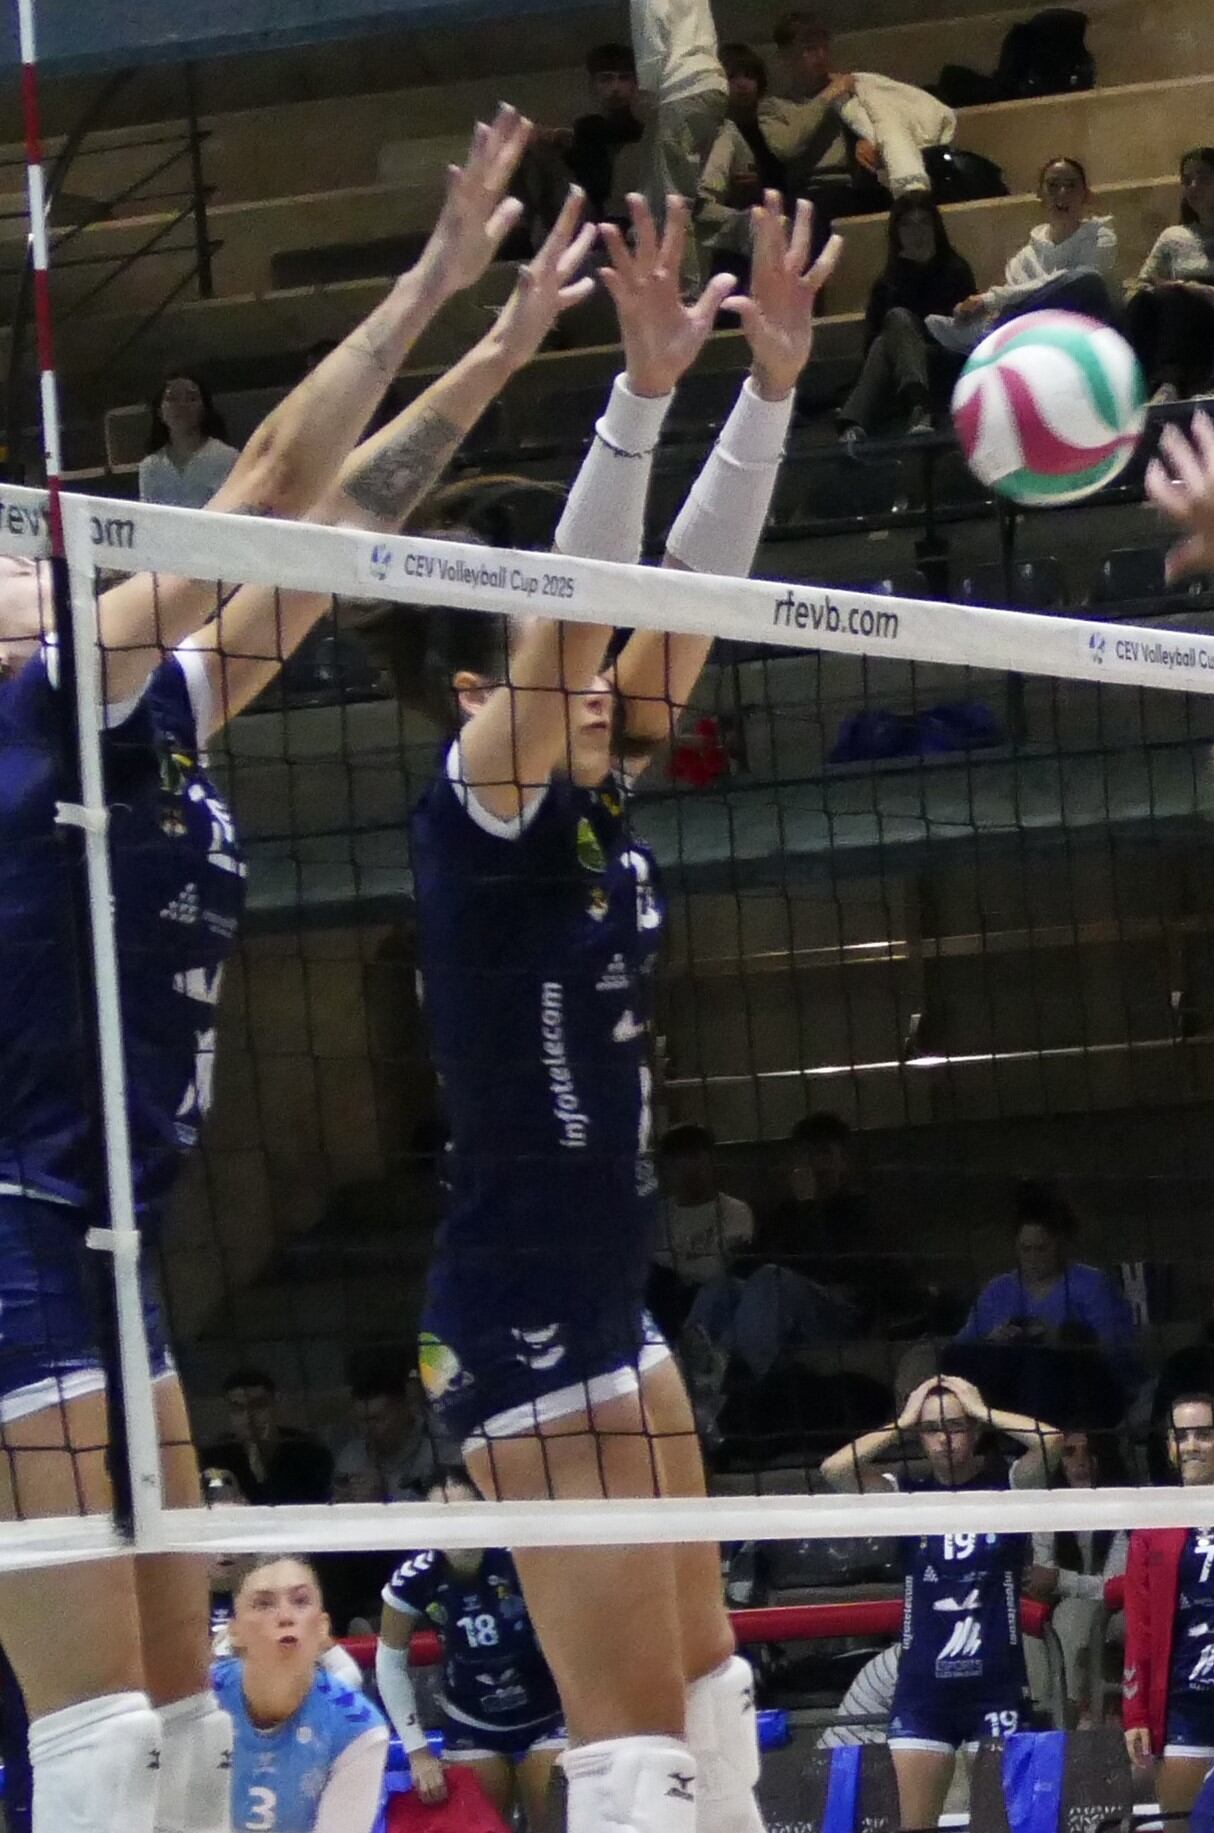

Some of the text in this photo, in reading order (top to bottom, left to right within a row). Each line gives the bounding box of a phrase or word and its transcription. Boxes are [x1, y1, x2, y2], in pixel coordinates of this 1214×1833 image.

[404, 554, 575, 599] CEV Volleyball Cup 2025
[773, 589, 899, 640] rfevb.com
[1115, 640, 1140, 661] CEV
[1140, 643, 1196, 669] Volleyball
[943, 1532, 977, 1561] 19
[456, 1613, 499, 1648] 18
[983, 1709, 1019, 1738] 19
[244, 1786, 277, 1831] 3
